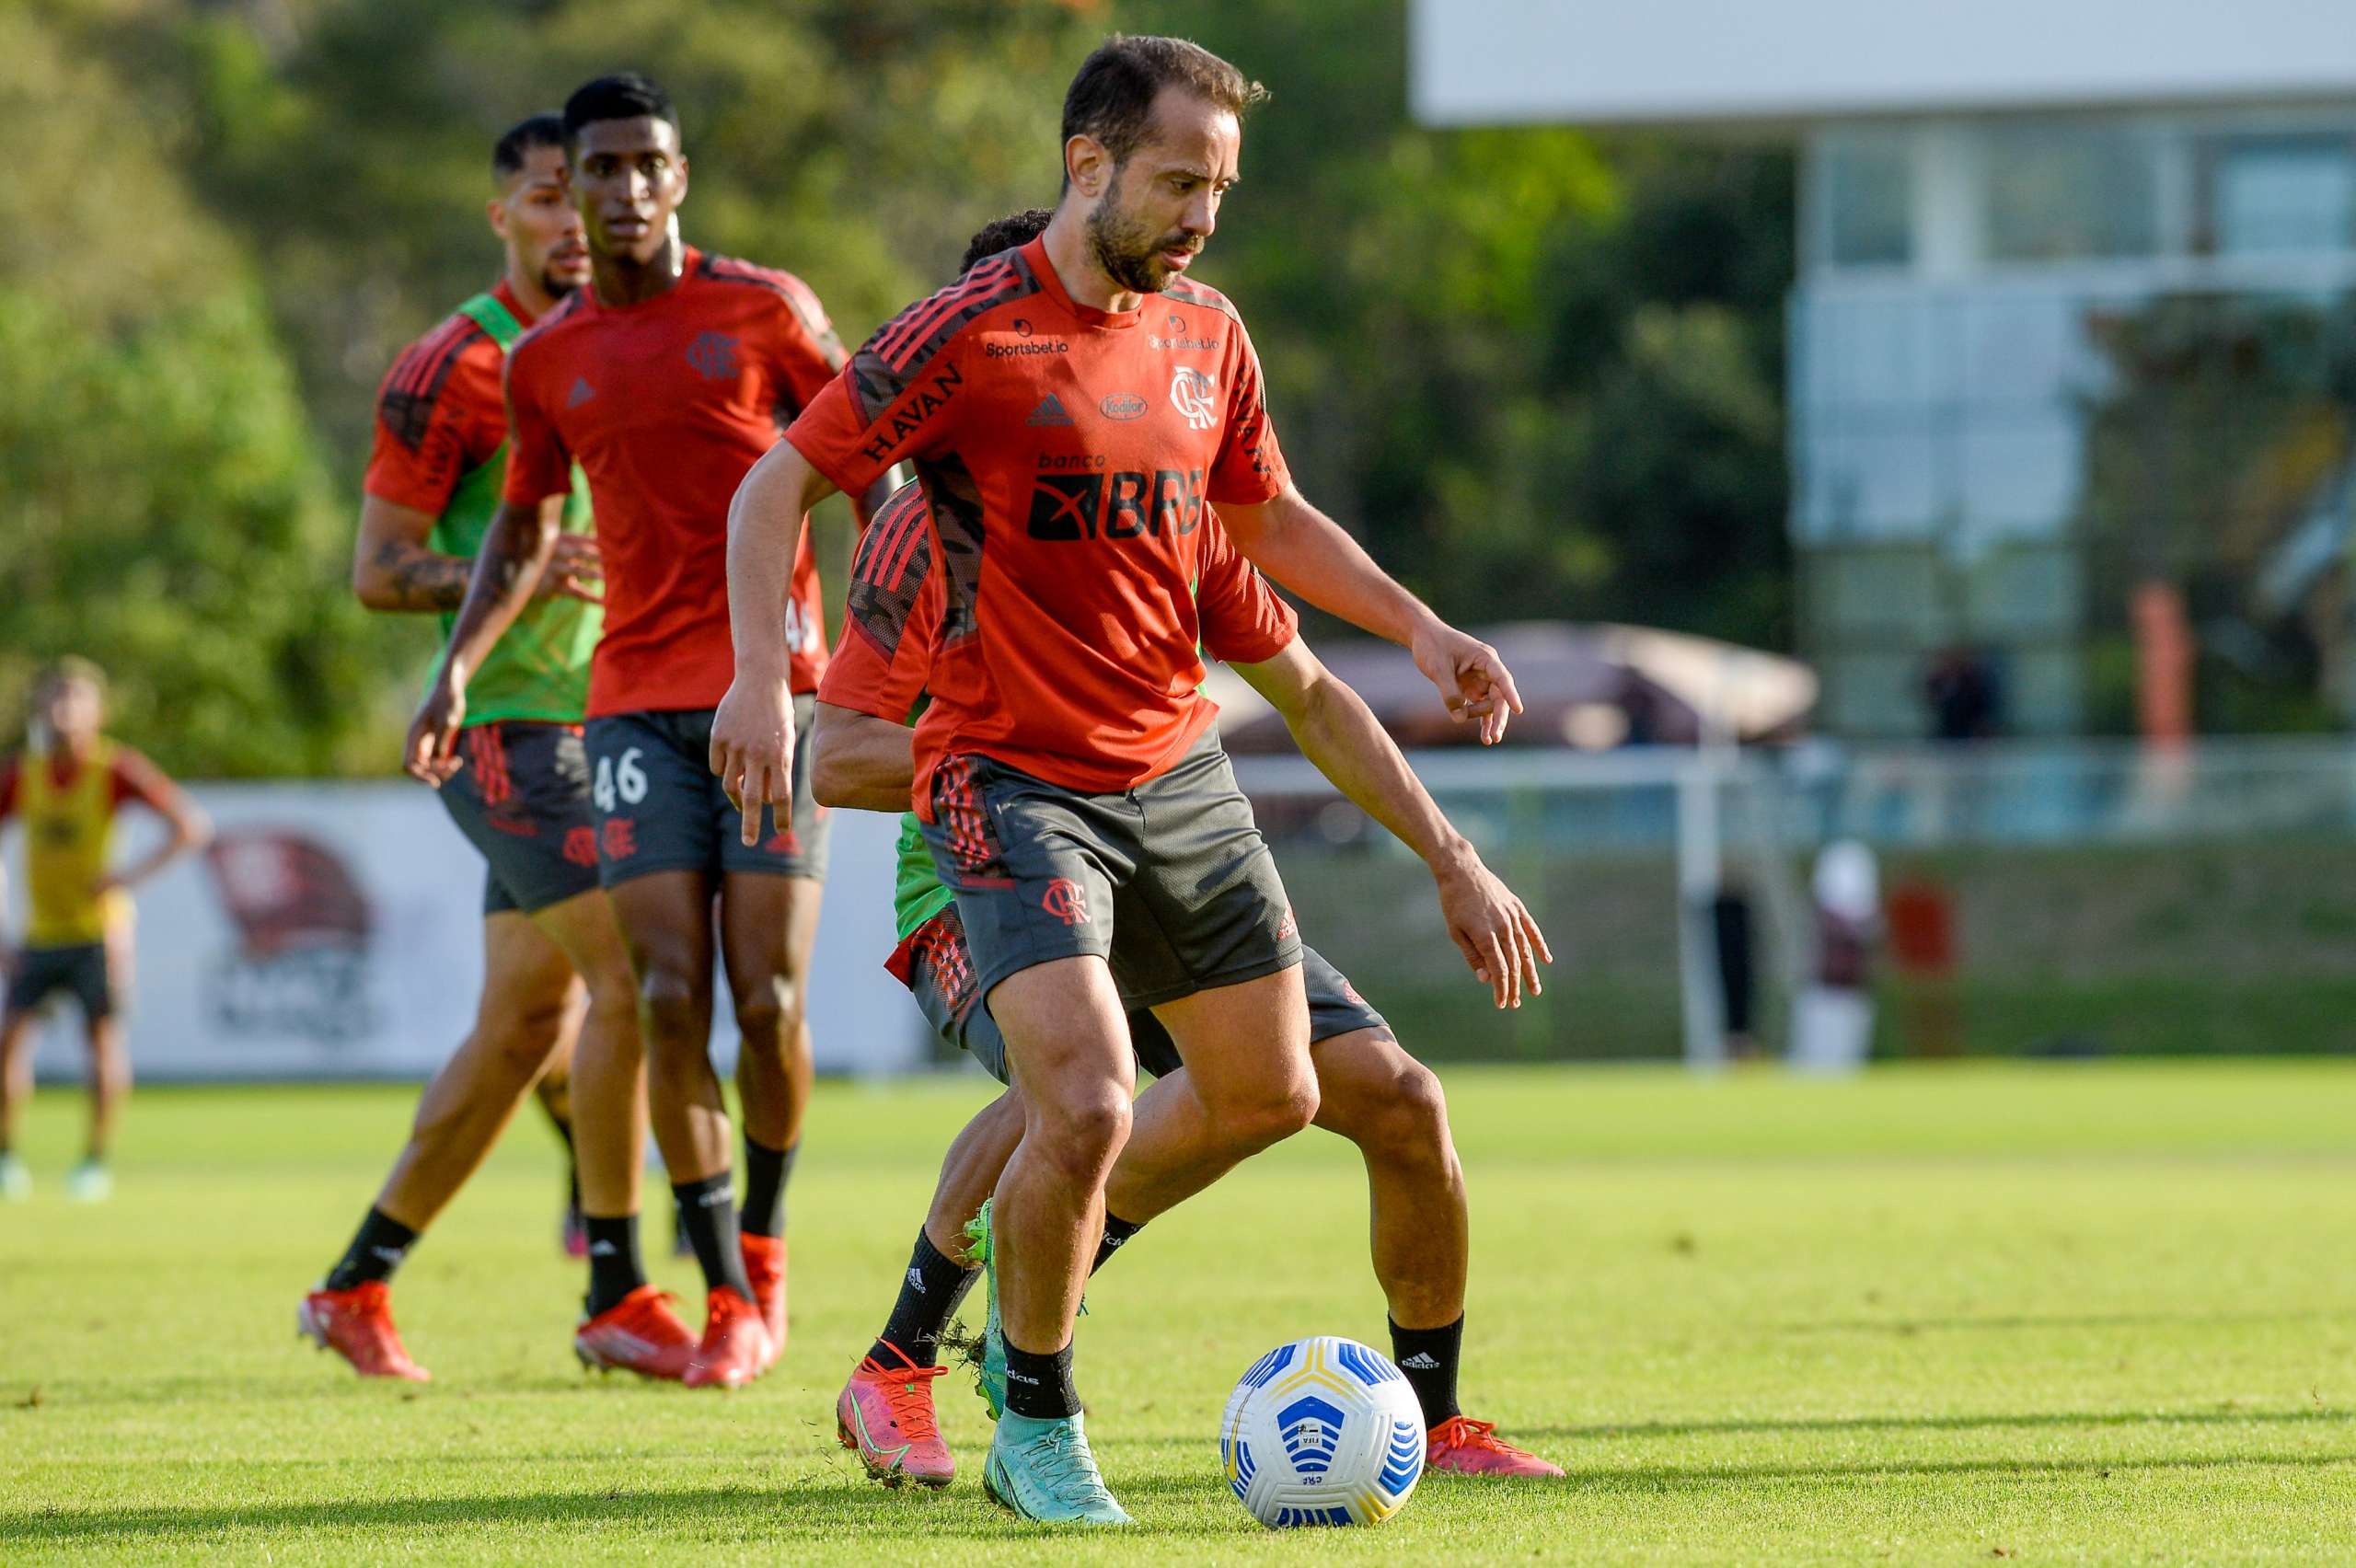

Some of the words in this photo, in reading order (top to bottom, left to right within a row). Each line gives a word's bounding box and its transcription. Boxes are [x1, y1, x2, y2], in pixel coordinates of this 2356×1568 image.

[986, 341, 1068, 358] Sportsbet.io
[862, 362, 963, 462] HAVAN
[1038, 453, 1106, 468] banco
[1106, 470, 1203, 538] BRB
[594, 746, 648, 812] 46
